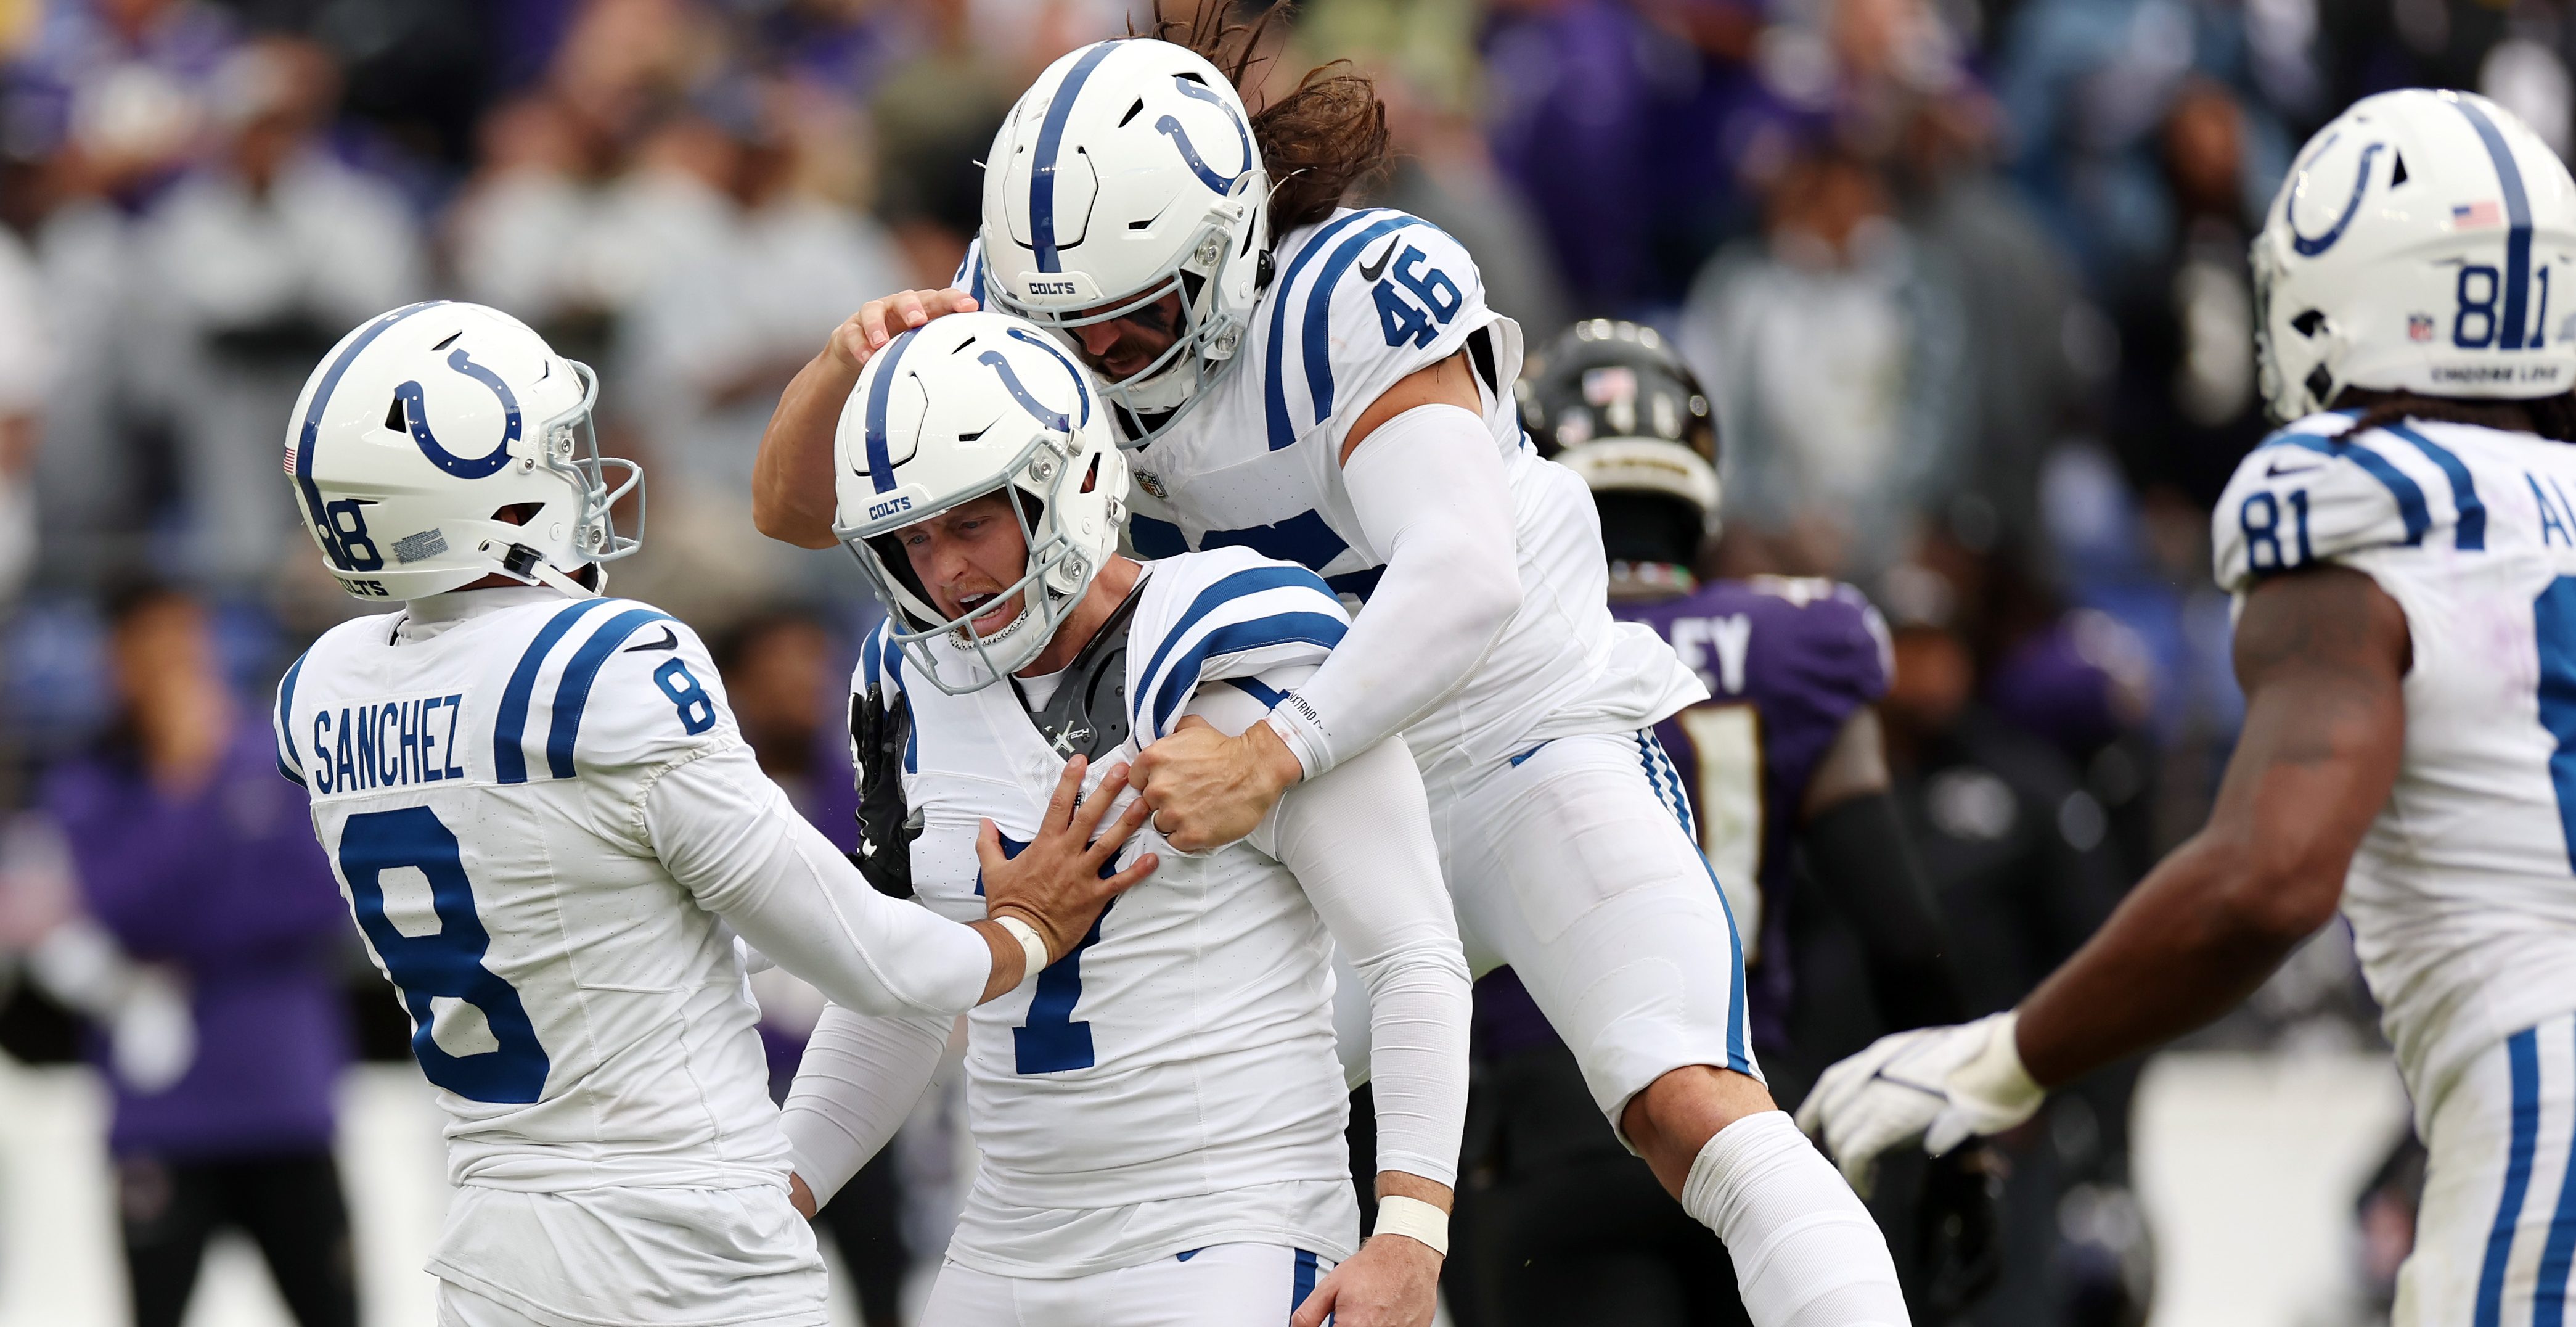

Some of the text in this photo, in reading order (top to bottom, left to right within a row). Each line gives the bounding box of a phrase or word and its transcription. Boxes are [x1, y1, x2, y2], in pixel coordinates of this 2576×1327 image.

[1029, 282, 1076, 294] COLTS
[1372, 244, 1462, 350] 46
[2453, 265, 2549, 350] 81
[326, 499, 384, 572] 8
[869, 496, 912, 521] COLTS
[2240, 488, 2314, 574] 81
[653, 657, 716, 736] 8
[314, 694, 464, 795] SANCHEZ
[338, 805, 550, 1104] 8
